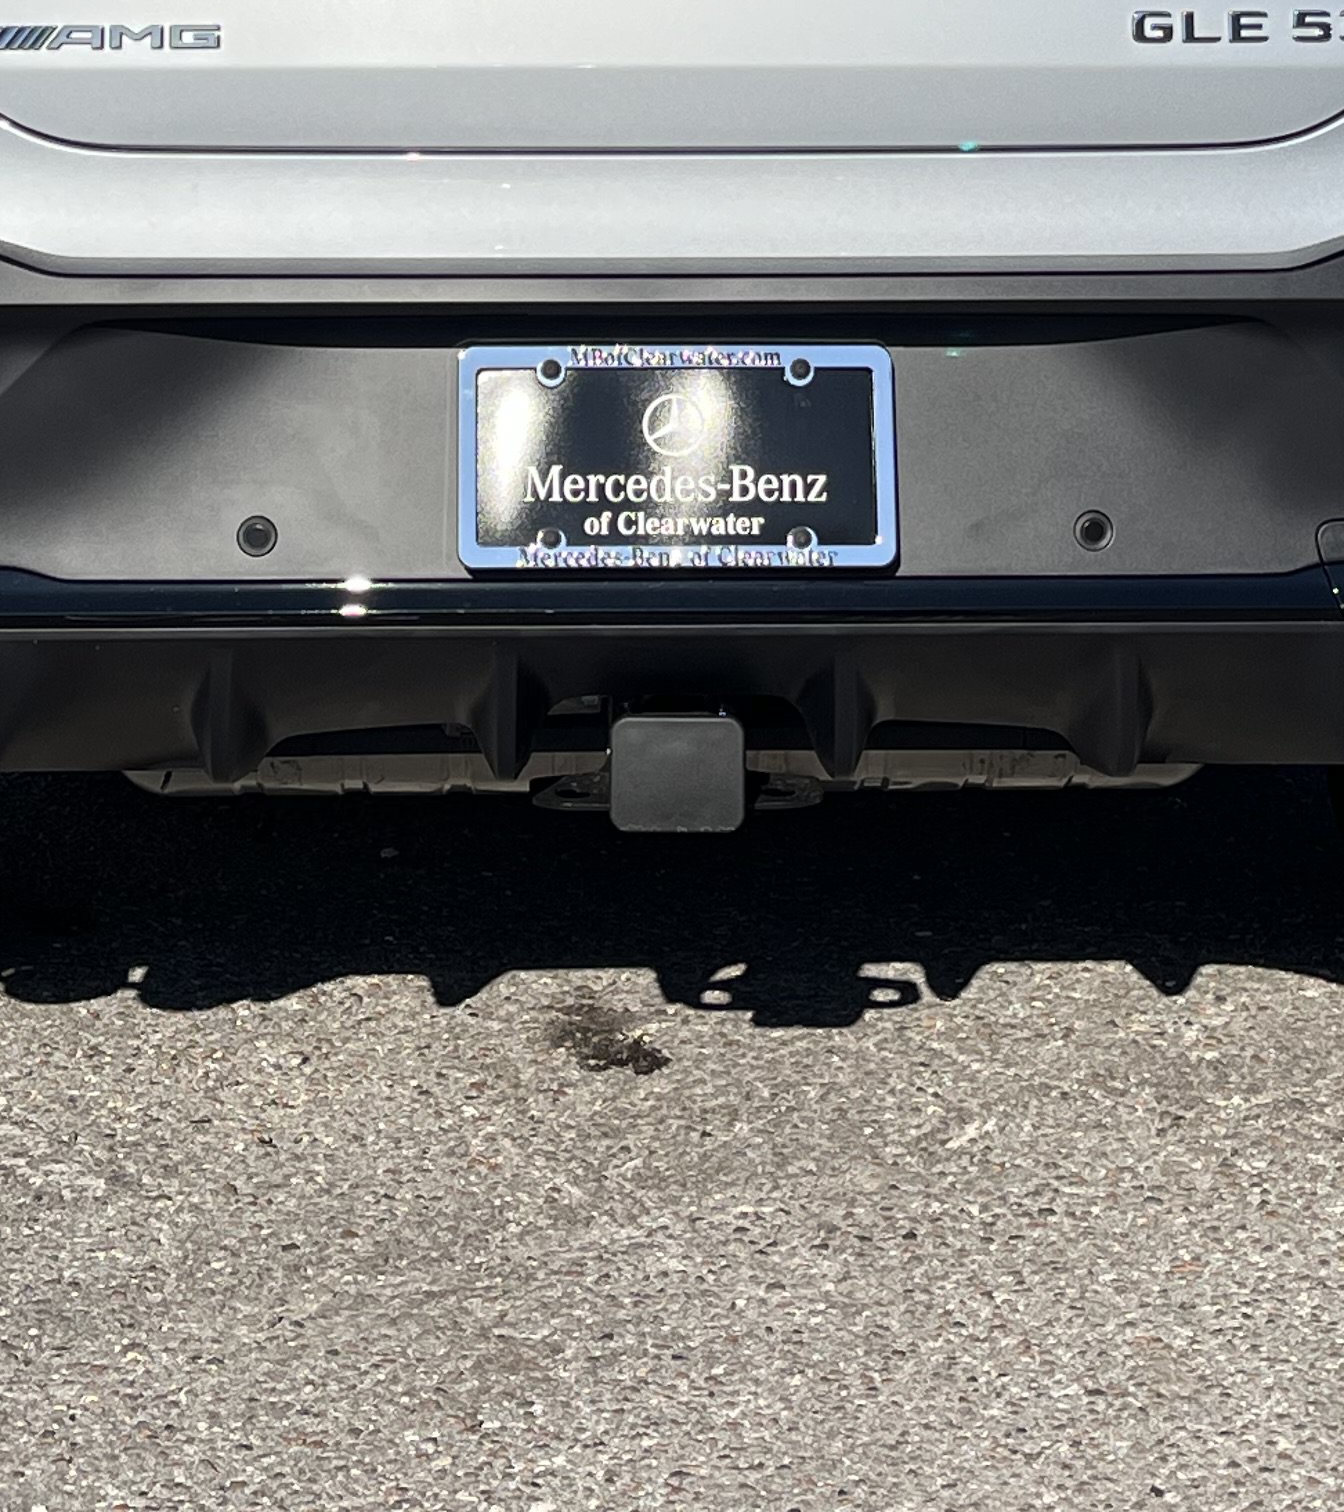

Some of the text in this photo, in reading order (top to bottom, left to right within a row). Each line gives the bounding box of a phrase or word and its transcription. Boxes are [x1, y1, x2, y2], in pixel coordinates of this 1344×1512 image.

[46, 25, 223, 50] AMG
[1131, 9, 1270, 44] GLE
[523, 464, 828, 503] Mercedes-Benz
[584, 510, 765, 536] of Clearwater
[516, 546, 839, 568] Mercedes-Ben of Clearwater
